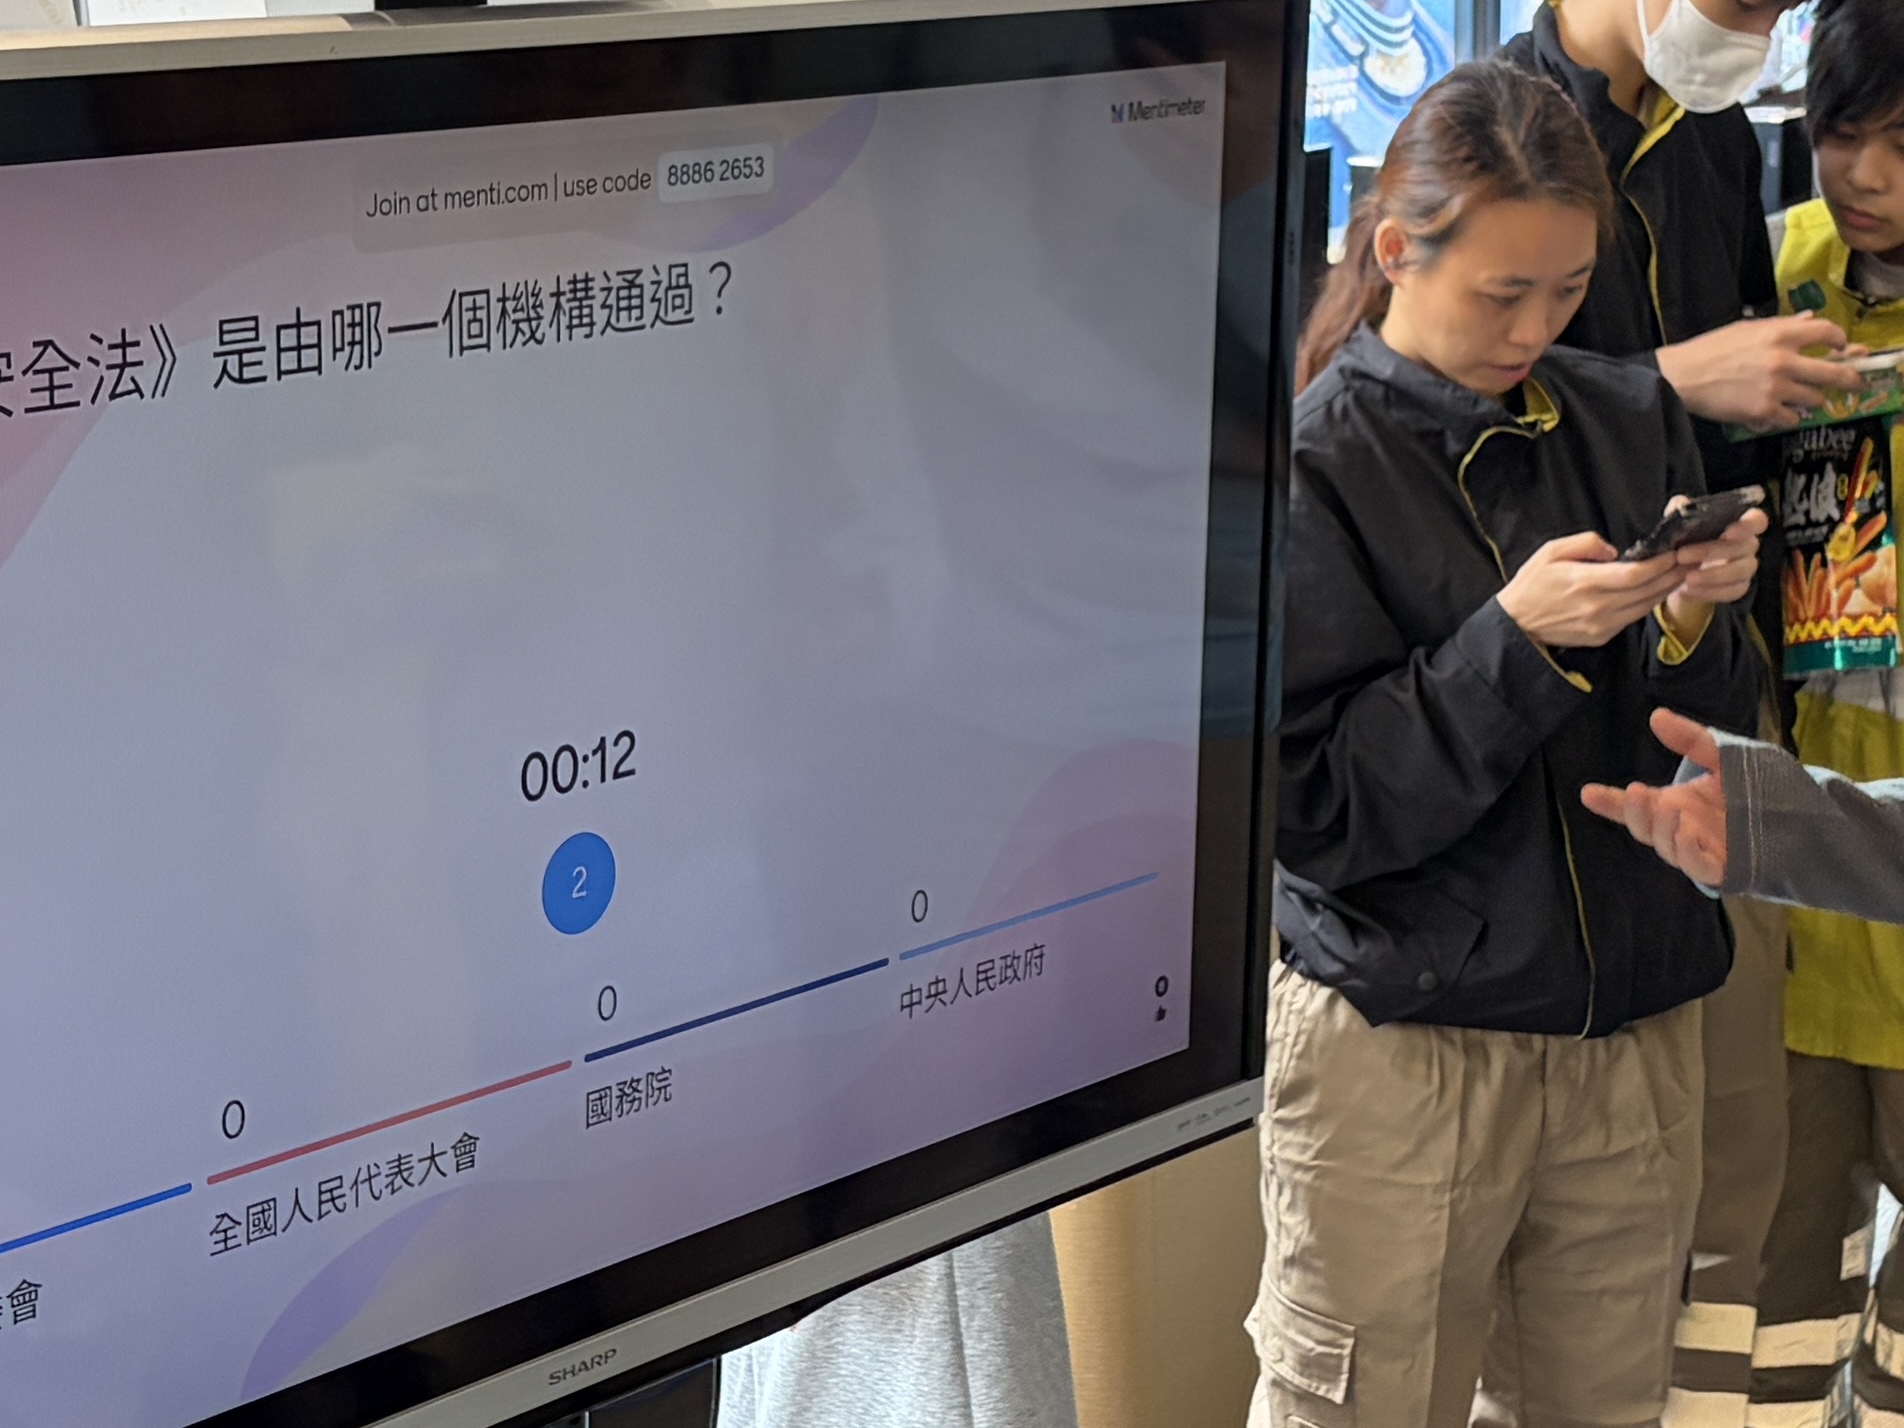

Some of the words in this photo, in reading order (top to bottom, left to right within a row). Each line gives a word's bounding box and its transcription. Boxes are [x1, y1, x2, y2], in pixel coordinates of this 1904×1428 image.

[366, 193, 411, 219] Join
[416, 189, 439, 213] at
[444, 181, 548, 211] menti.com
[563, 176, 597, 198] use
[603, 168, 652, 195] code
[667, 160, 715, 187] 8886
[720, 156, 765, 182] 2653
[520, 729, 637, 802] 00:12
[570, 866, 587, 900] 2
[910, 889, 929, 923] 0
[597, 985, 618, 1021] 0
[899, 943, 1046, 1020] 中央人民政府
[221, 1100, 245, 1139] 0
[585, 1065, 674, 1131] 國務院
[208, 1132, 481, 1257] 全國人民代表大會
[548, 1348, 618, 1386] SHARP
